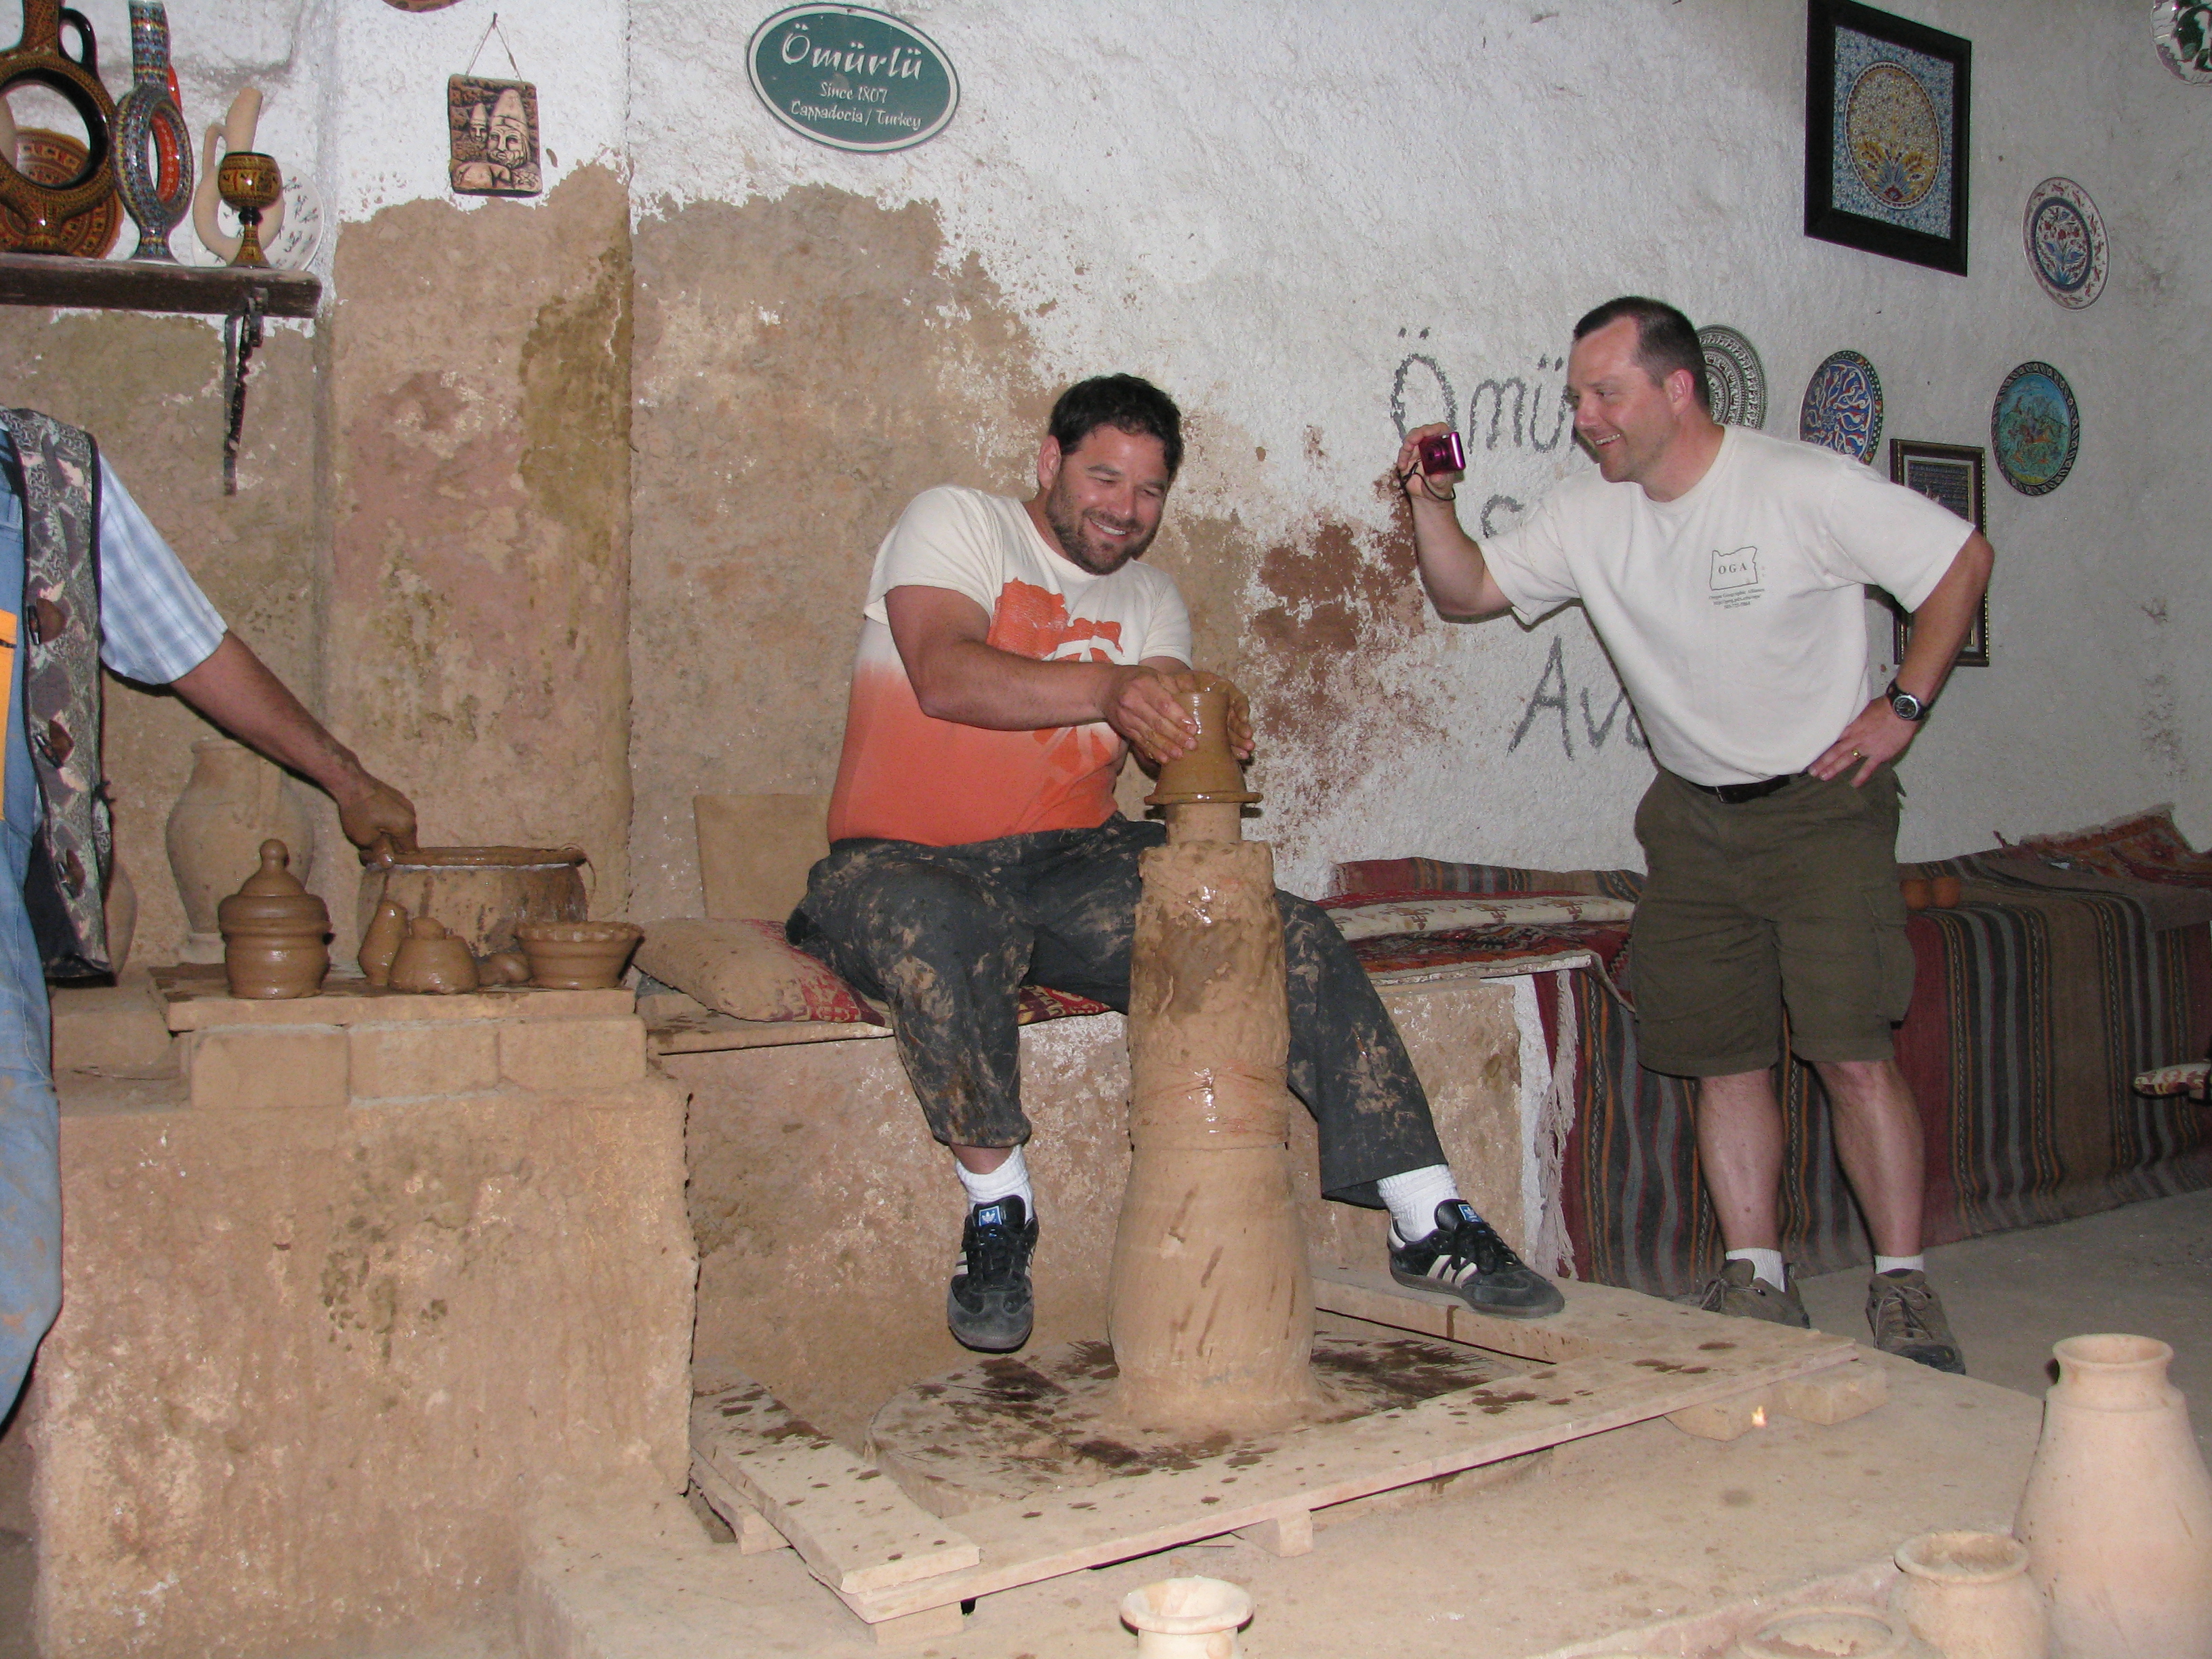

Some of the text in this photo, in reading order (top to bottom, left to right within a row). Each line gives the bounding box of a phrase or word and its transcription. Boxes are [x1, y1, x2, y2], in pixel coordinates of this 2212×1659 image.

[782, 22, 922, 80] Ömürlü
[820, 81, 854, 100] Since
[791, 100, 863, 123] Cappadocia
[876, 110, 921, 131] Turkey
[1391, 327, 1577, 453] Ömü
